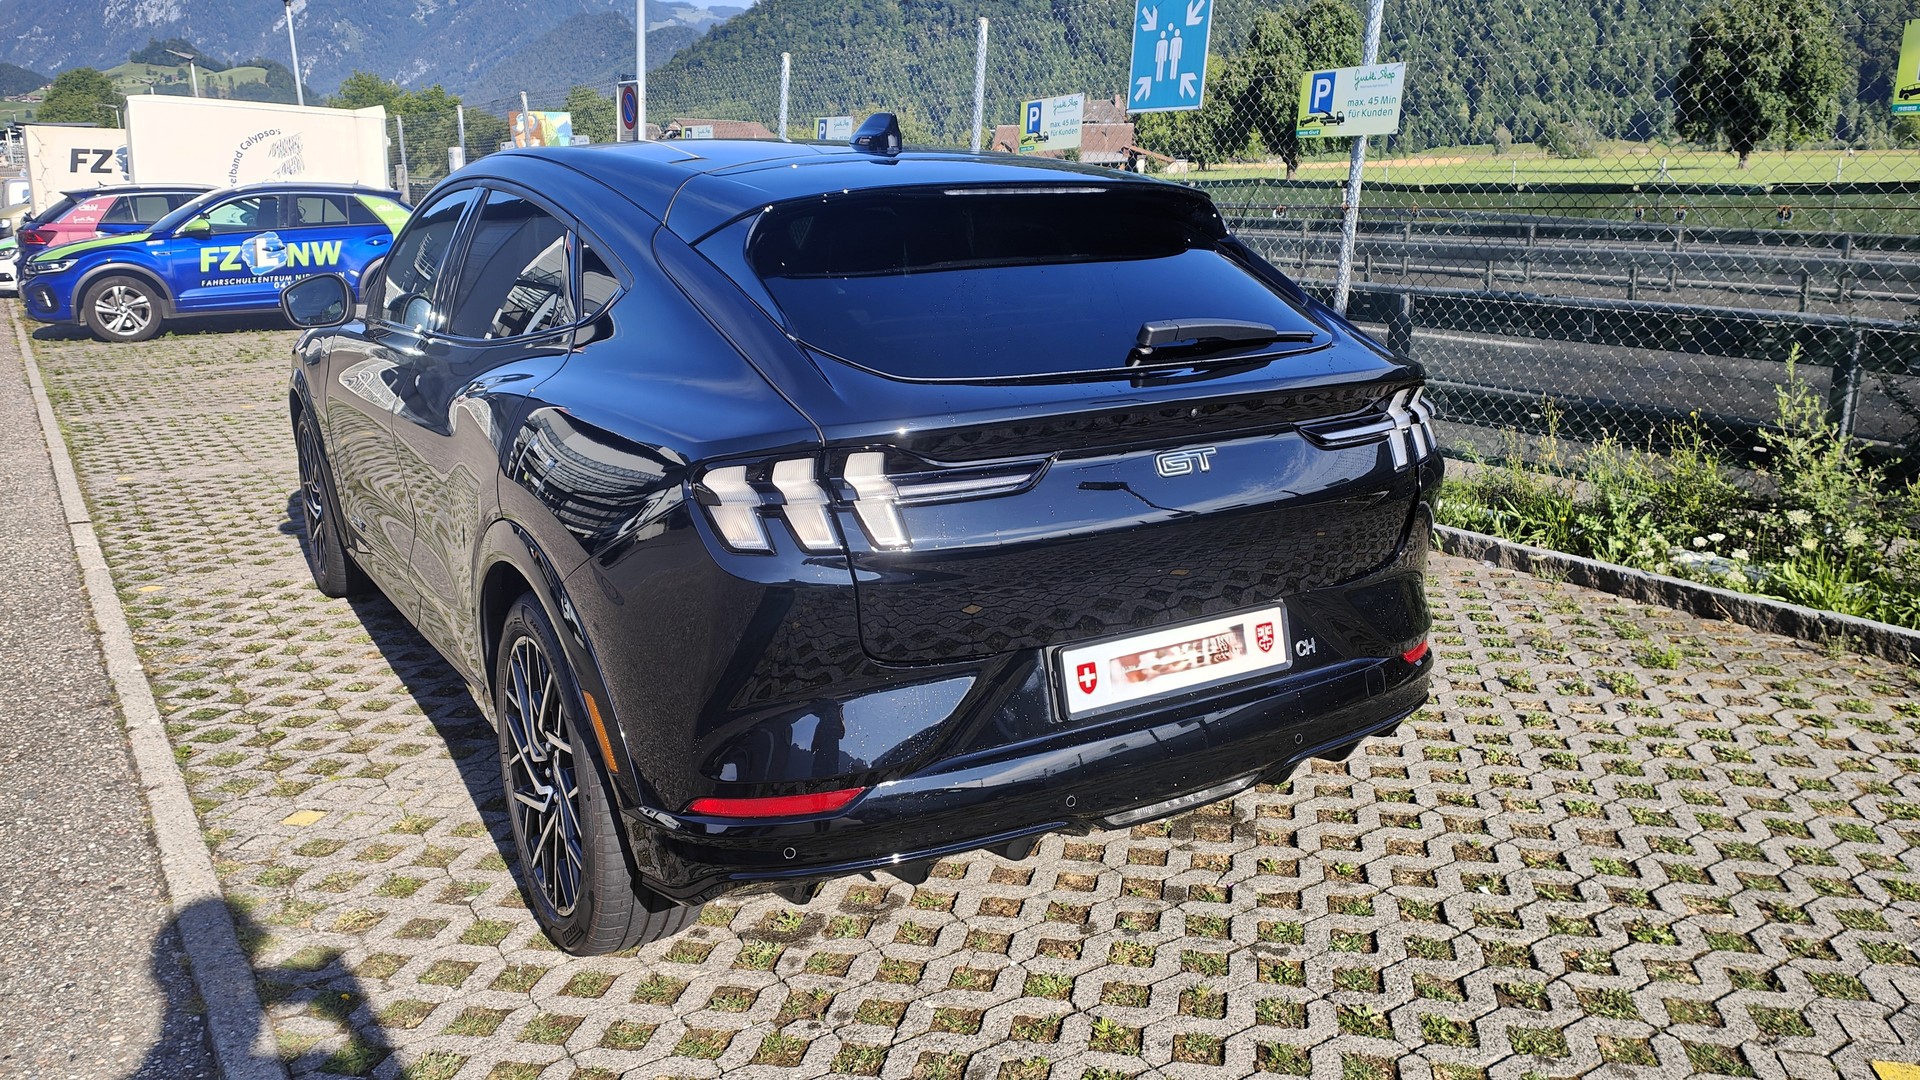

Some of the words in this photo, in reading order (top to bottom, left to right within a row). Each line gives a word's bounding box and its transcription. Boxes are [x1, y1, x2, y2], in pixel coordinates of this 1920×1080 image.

[1347, 99, 1366, 107] max.
[1368, 96, 1379, 106] 45
[1380, 95, 1397, 105] Min
[1348, 109, 1360, 118] für
[1361, 108, 1393, 117] Kunden
[202, 275, 291, 286] FAHRSCHULZENTRUM
[1154, 446, 1217, 478] GT
[1295, 637, 1316, 657] CH
